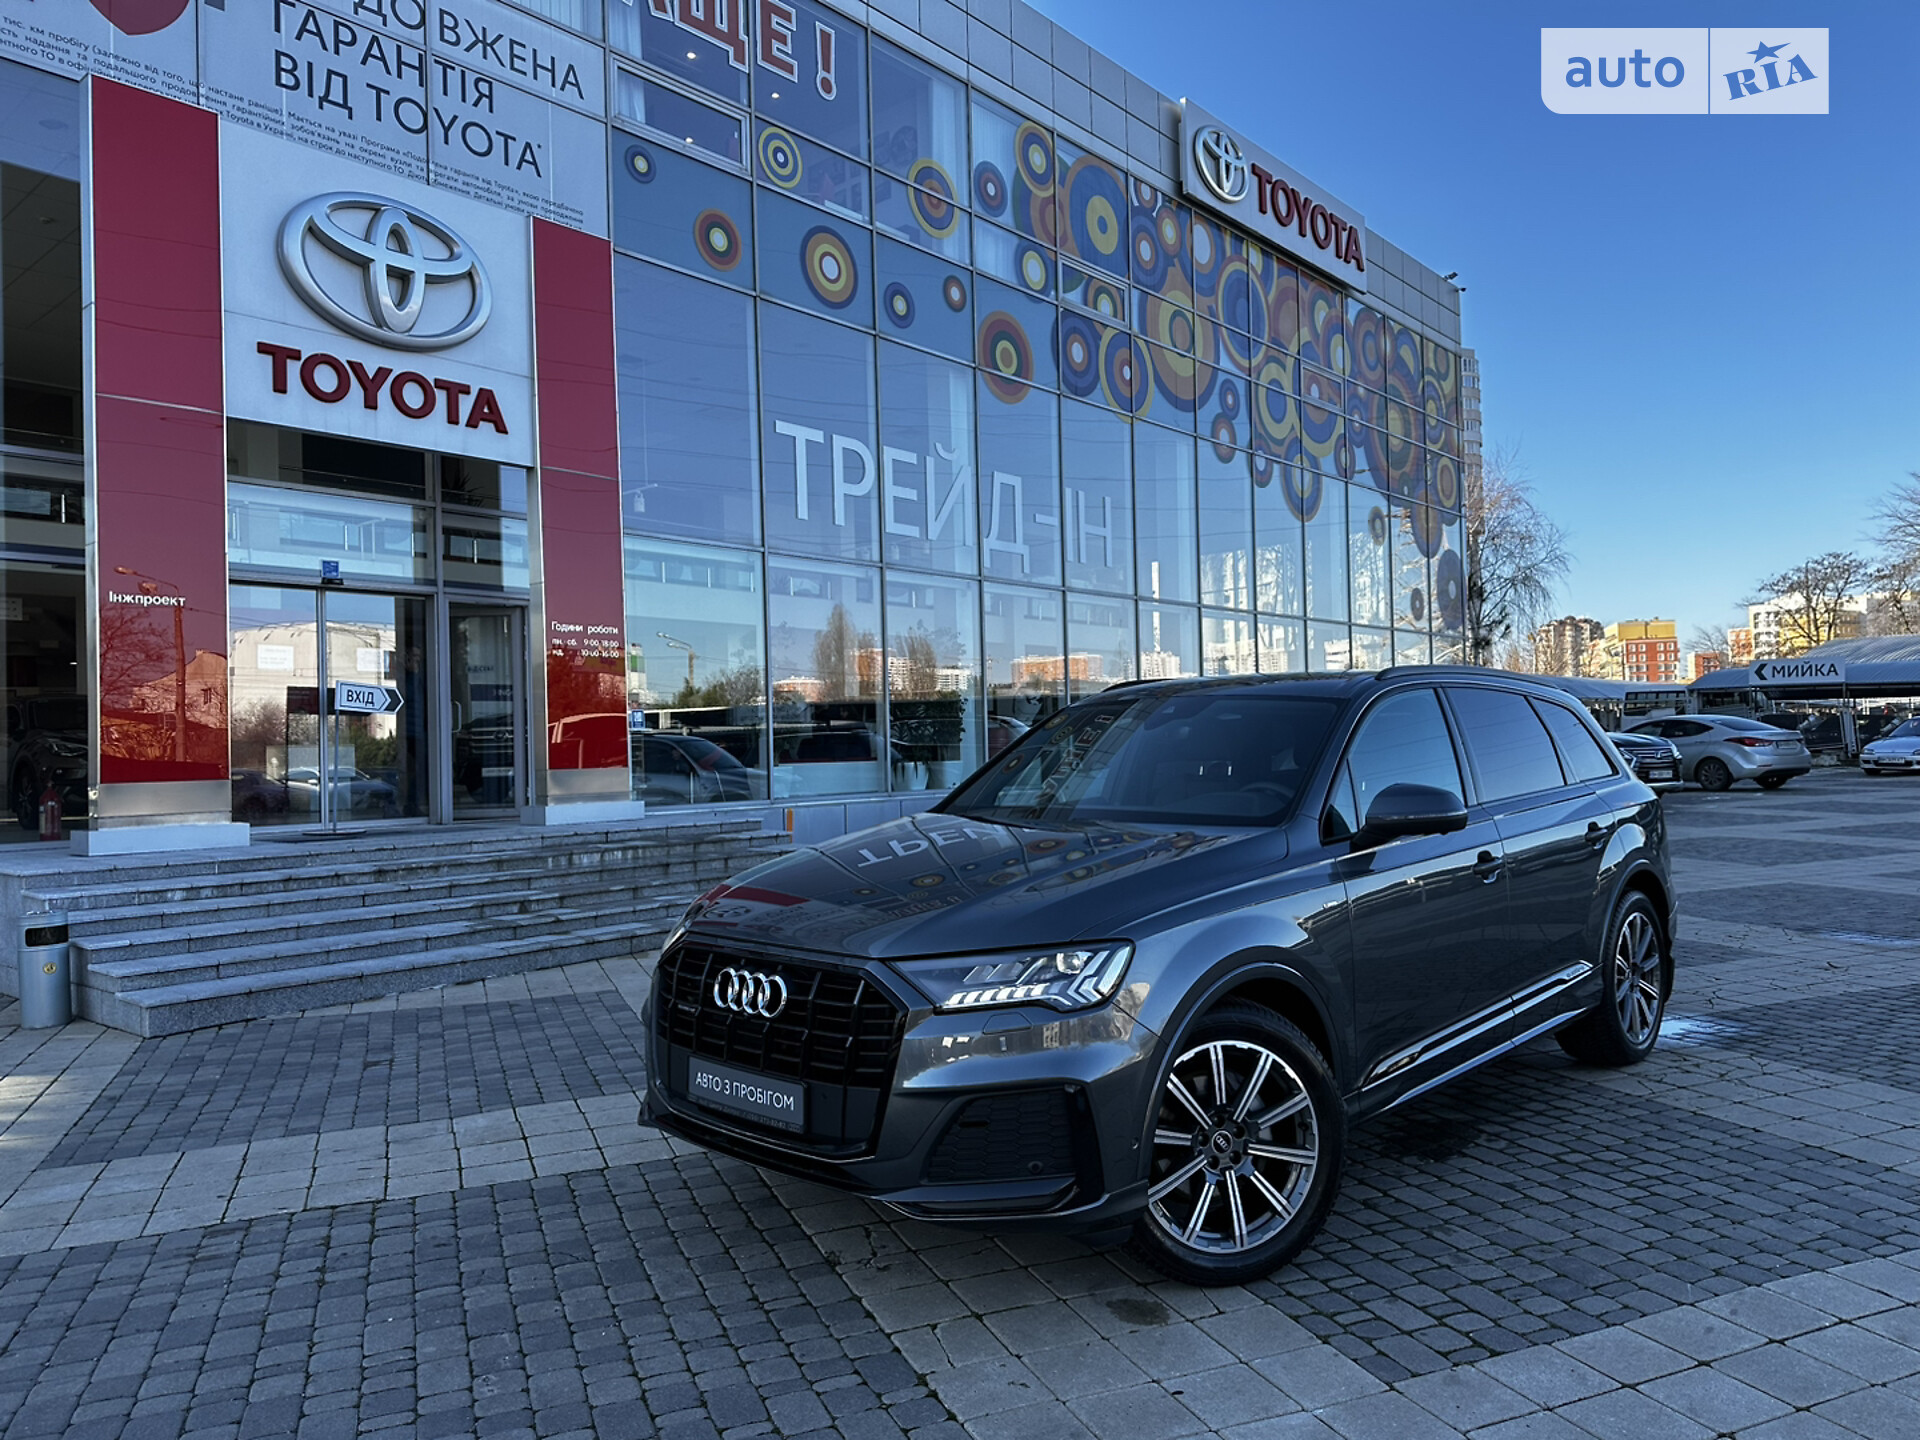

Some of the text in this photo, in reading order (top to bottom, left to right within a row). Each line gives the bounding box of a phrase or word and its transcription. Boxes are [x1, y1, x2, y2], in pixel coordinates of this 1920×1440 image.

[24, 35, 70, 56] надання
[76, 51, 87, 61] та
[93, 57, 156, 84] подальшого
[344, 141, 354, 149] на
[359, 146, 385, 160] окремі
[415, 164, 424, 172] та
[29, 25, 44, 36] км
[48, 30, 89, 53] пробігу
[91, 43, 140, 68] (залежно
[144, 61, 158, 75] від
[162, 69, 185, 84] того,
[208, 86, 244, 103] настане
[287, 110, 321, 129] Мається
[324, 124, 335, 133] на
[338, 128, 357, 142] увазі
[360, 134, 400, 155] Програма
[273, 1, 495, 114] ГАРАНТІЯ
[274, 49, 353, 121] ВІД
[40, 48, 55, 61] ТО
[58, 56, 64, 64] в
[225, 110, 253, 127] Toyota
[297, 135, 308, 143] на
[310, 139, 332, 153] строк
[334, 147, 345, 156] до
[347, 151, 392, 172] наступного
[1251, 162, 1365, 272] TOYOTA
[257, 341, 509, 435] TOYOTA
[775, 419, 1113, 574] ТРЕЙД-ІН
[109, 591, 186, 607] Інжпроект
[551, 621, 618, 634] Години роботи
[346, 689, 375, 706] ВХІД
[1771, 661, 1839, 678] МИЙКА
[695, 1071, 721, 1093] АВТО
[732, 1082, 795, 1111] ПРОБІГОМ
